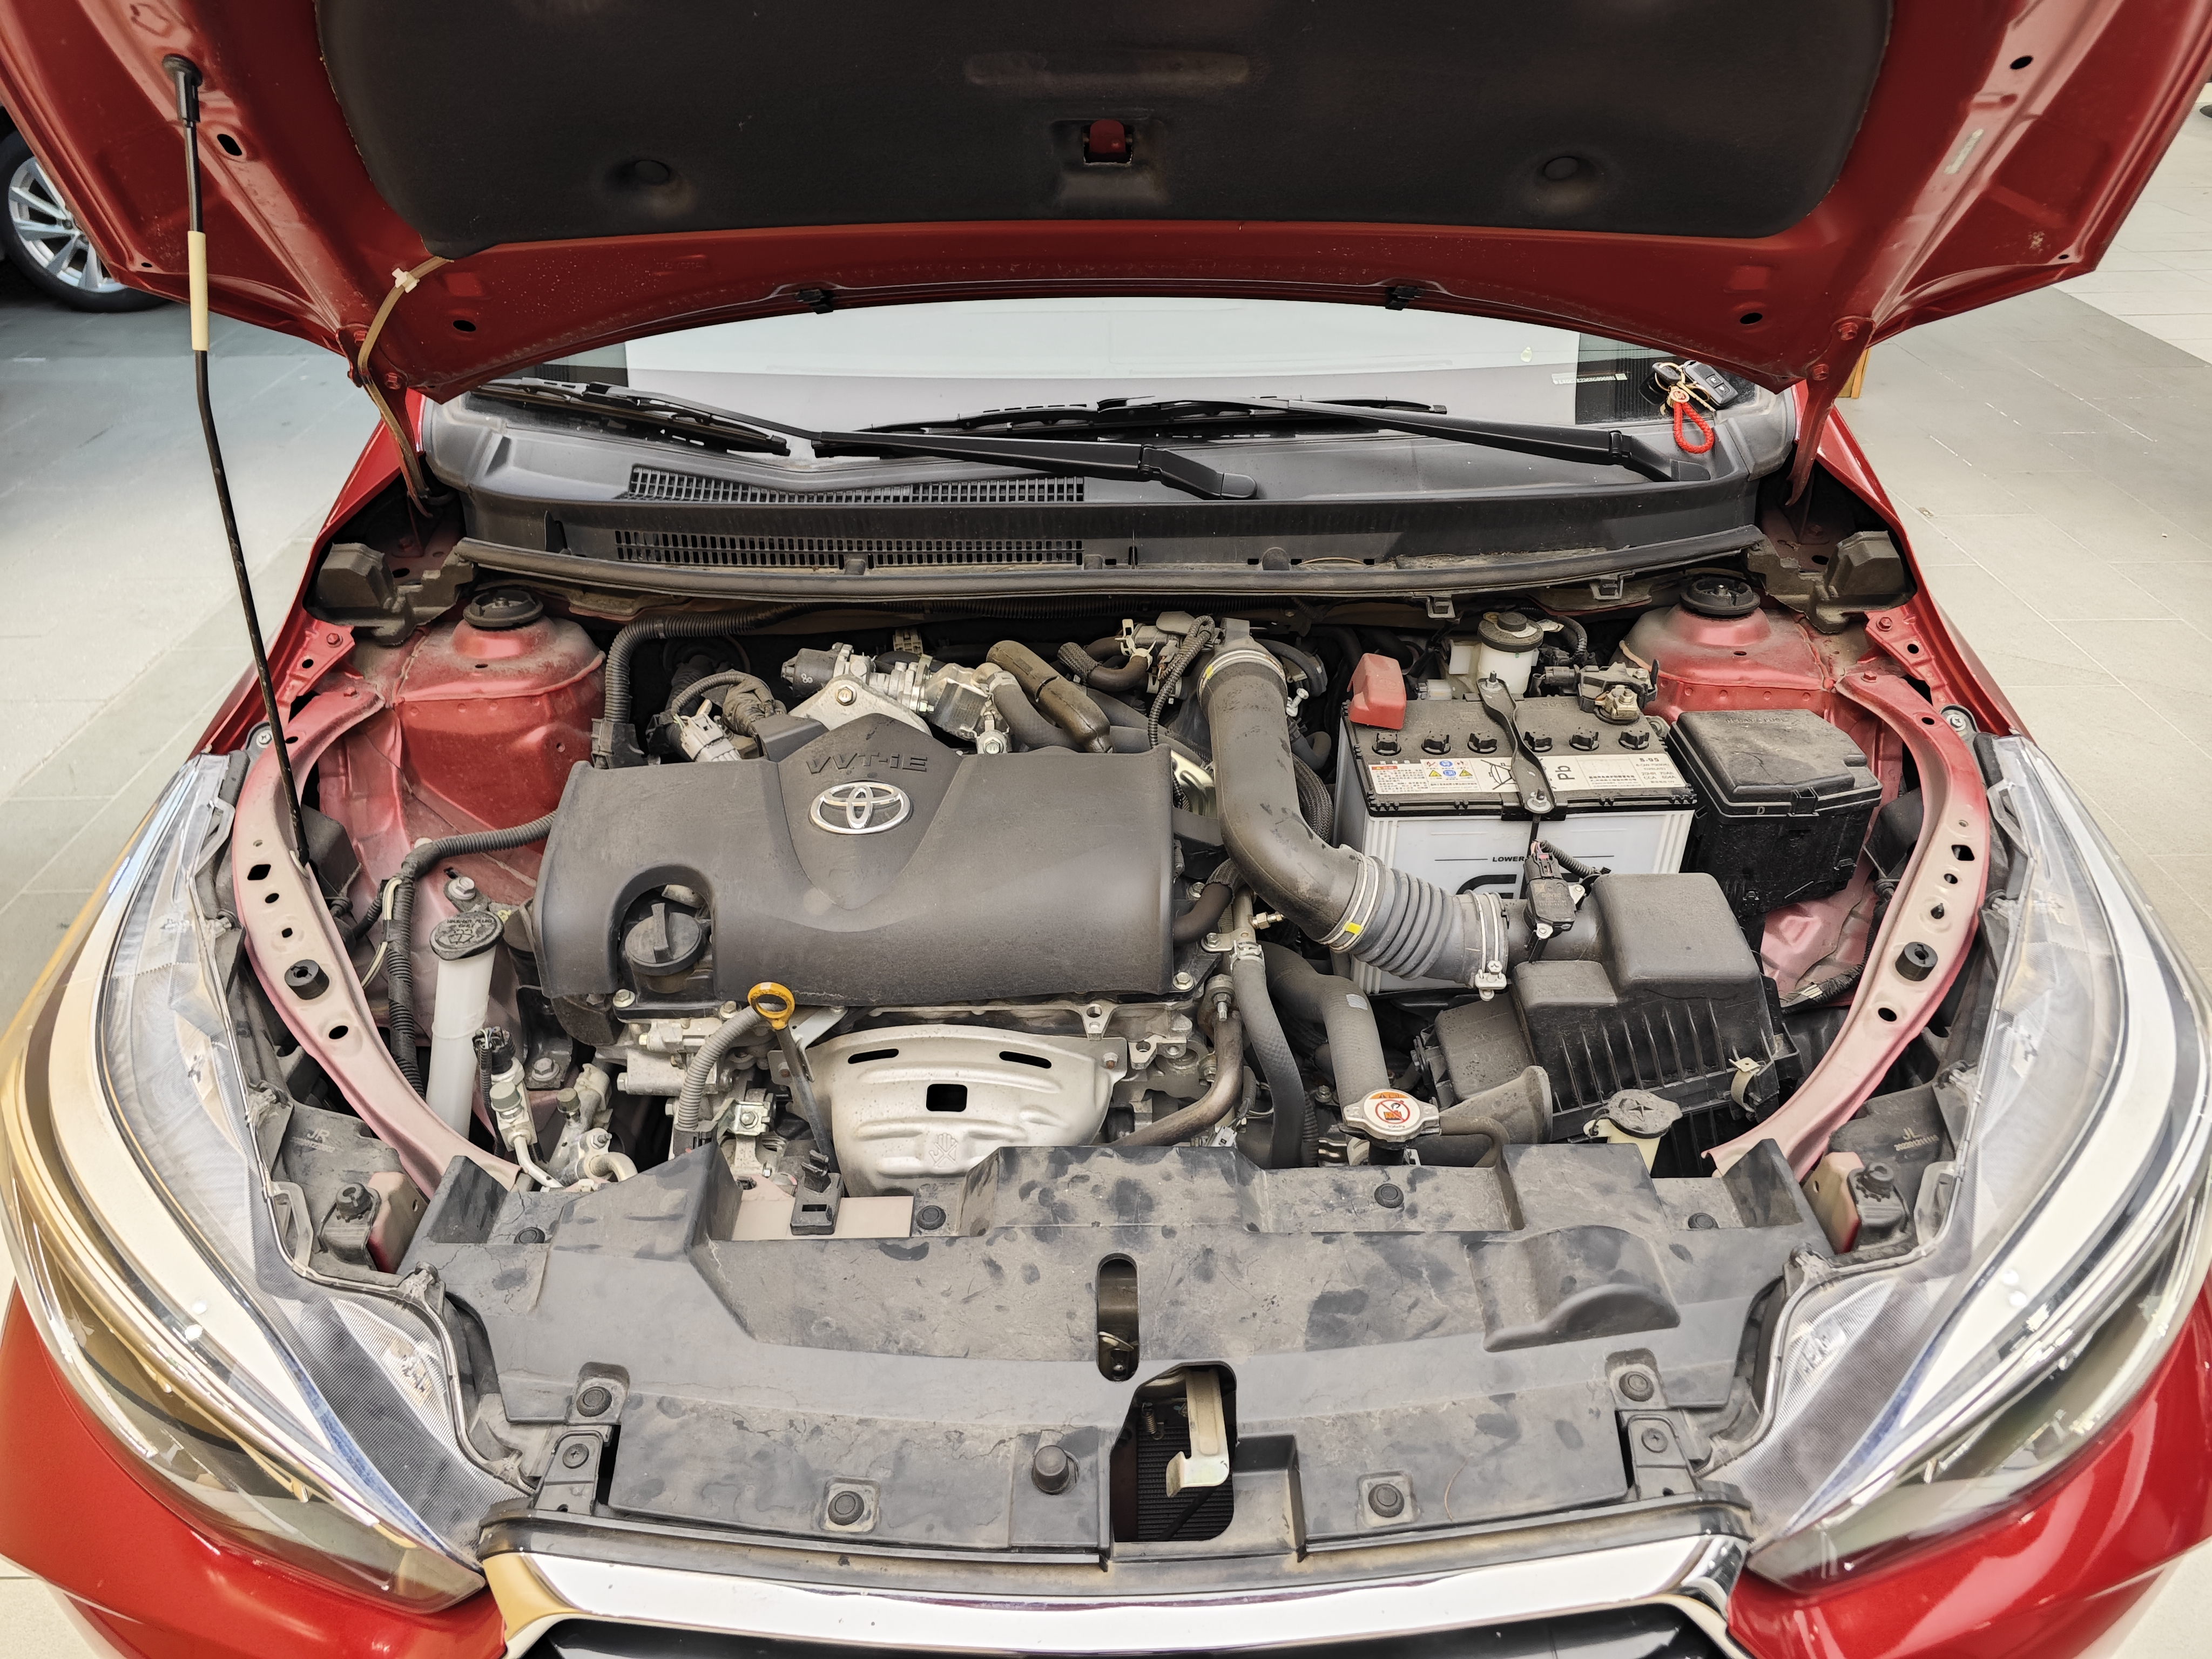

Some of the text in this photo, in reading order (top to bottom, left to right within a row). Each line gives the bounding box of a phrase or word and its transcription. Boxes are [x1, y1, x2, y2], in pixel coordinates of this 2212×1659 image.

[1555, 766, 1575, 780] Pb
[1757, 806, 1765, 814] D
[307, 1128, 331, 1143] JR
[1903, 1127, 1924, 1140] JL
